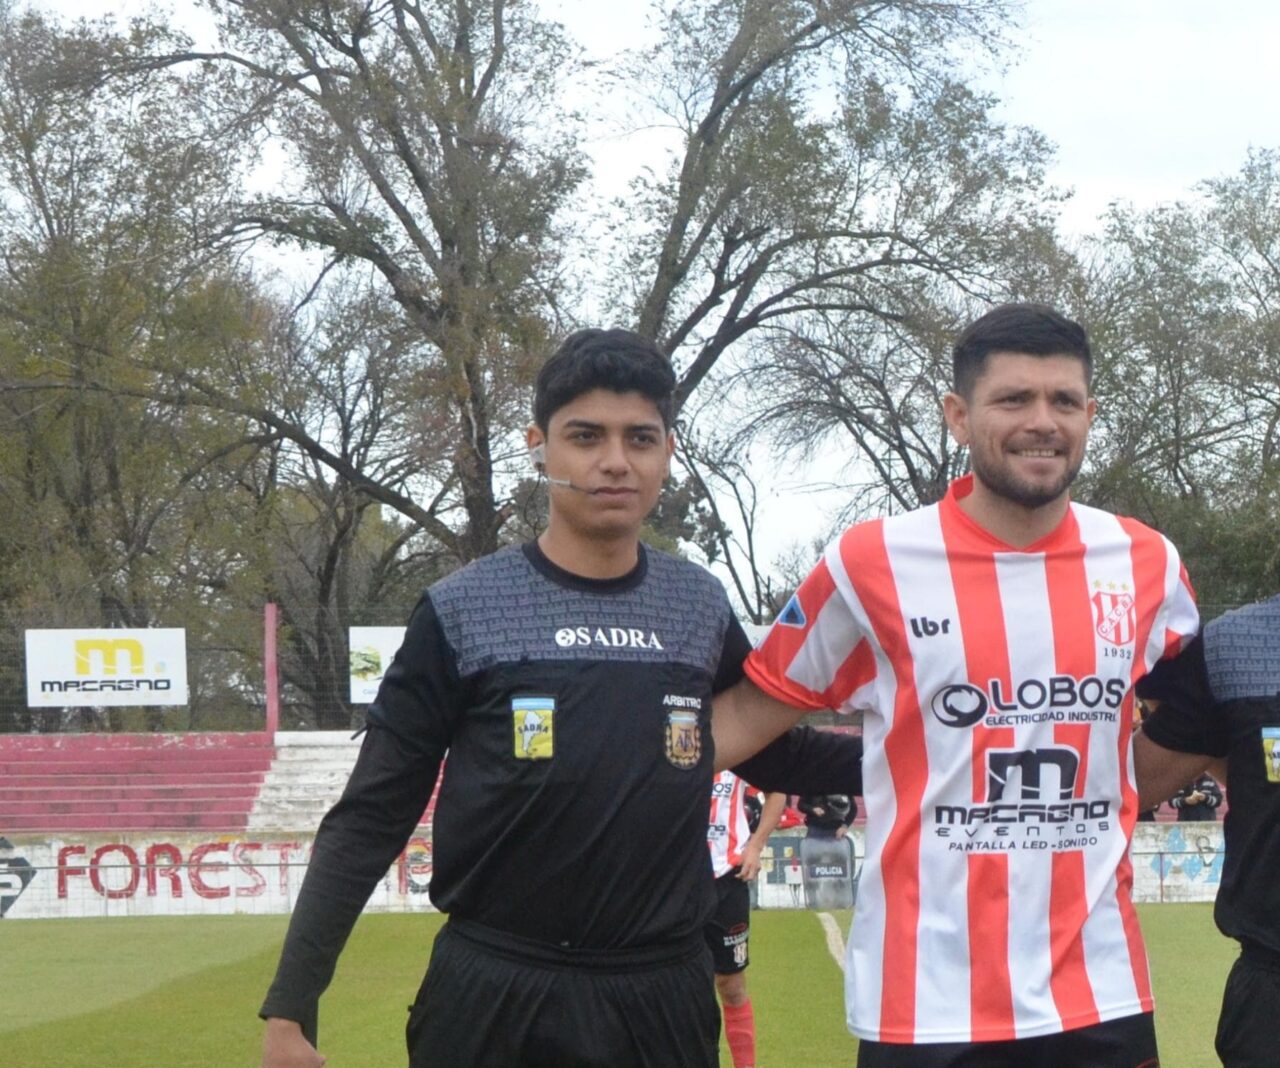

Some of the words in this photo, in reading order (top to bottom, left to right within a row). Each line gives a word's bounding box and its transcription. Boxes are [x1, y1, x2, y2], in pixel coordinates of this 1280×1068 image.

[576, 627, 664, 650] SADRA
[1104, 647, 1132, 660] 1932
[991, 676, 1125, 711] LOBOS
[985, 713, 1064, 726] ELECTRICIDAD
[934, 821, 1110, 838] EVENTOS
[949, 840, 1016, 850] PANTALLA
[1022, 840, 1048, 850] LED
[815, 866, 844, 876] POLICIA
